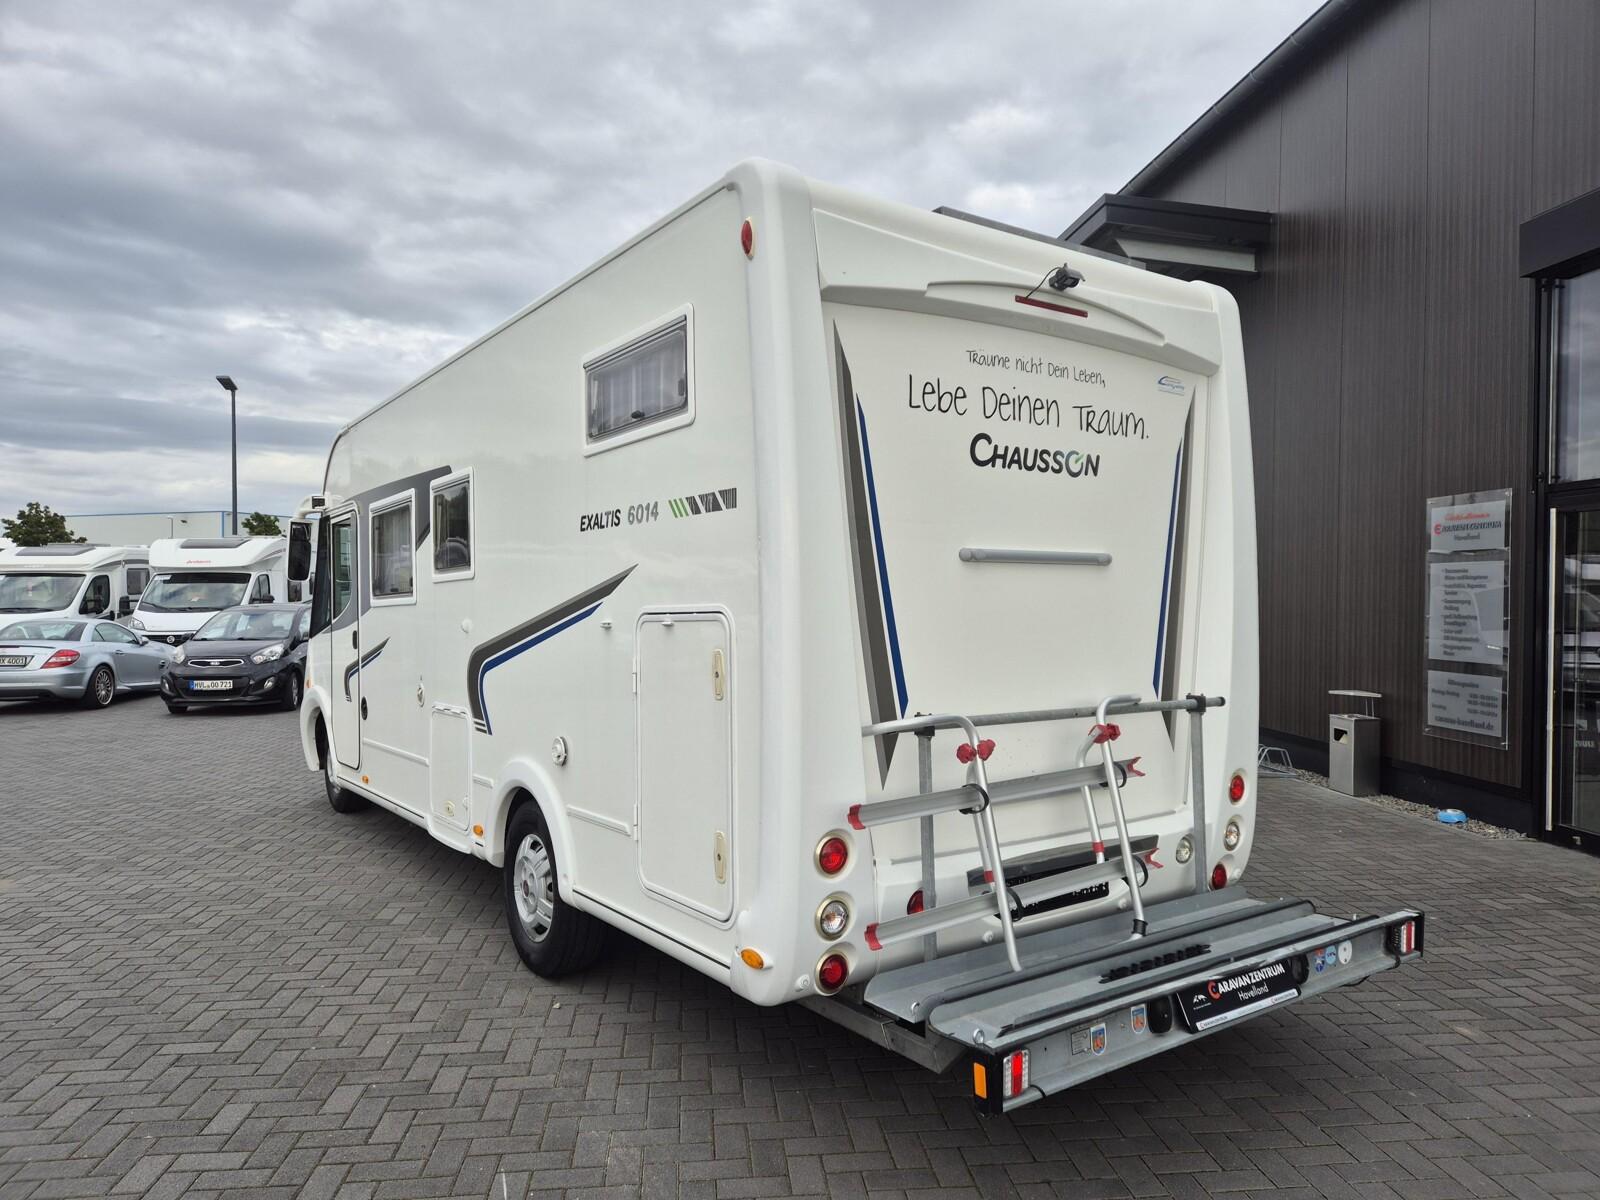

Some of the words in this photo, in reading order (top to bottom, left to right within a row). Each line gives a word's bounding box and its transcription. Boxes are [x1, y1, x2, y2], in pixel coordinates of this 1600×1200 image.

[1015, 355, 1043, 374] nicht
[1047, 362, 1069, 379] Dein
[1073, 366, 1106, 388] Leben,
[909, 374, 967, 415] Lebe
[982, 386, 1060, 428] Deinen
[969, 432, 1100, 477] CHAUSSON
[580, 509, 621, 532] EXALTIS
[627, 501, 659, 525] 6014
[1207, 963, 1286, 1000] CARAVANZENTRUM
[1238, 981, 1269, 1000] Havelland
